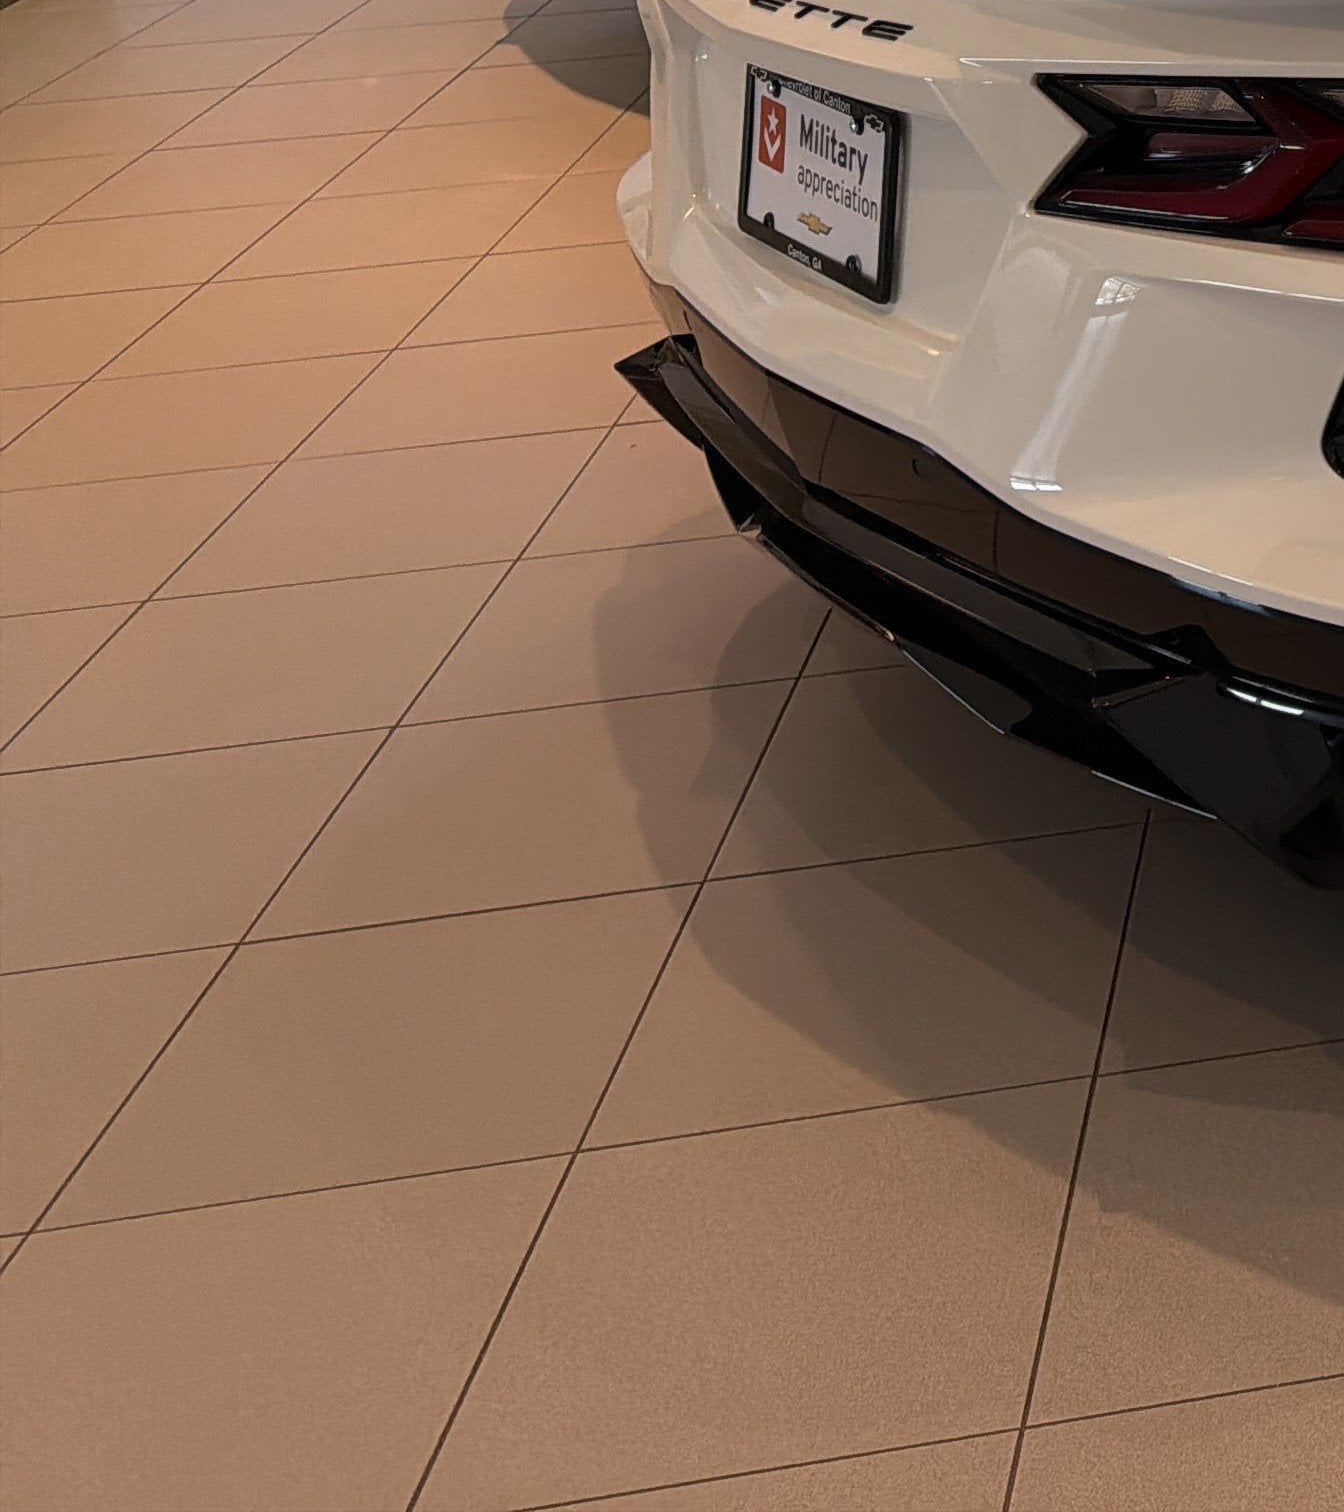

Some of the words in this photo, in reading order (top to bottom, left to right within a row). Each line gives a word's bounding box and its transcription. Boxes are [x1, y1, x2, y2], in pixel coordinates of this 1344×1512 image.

[823, 90, 851, 114] Canton
[799, 113, 868, 185] Military
[797, 163, 878, 223] appreciation
